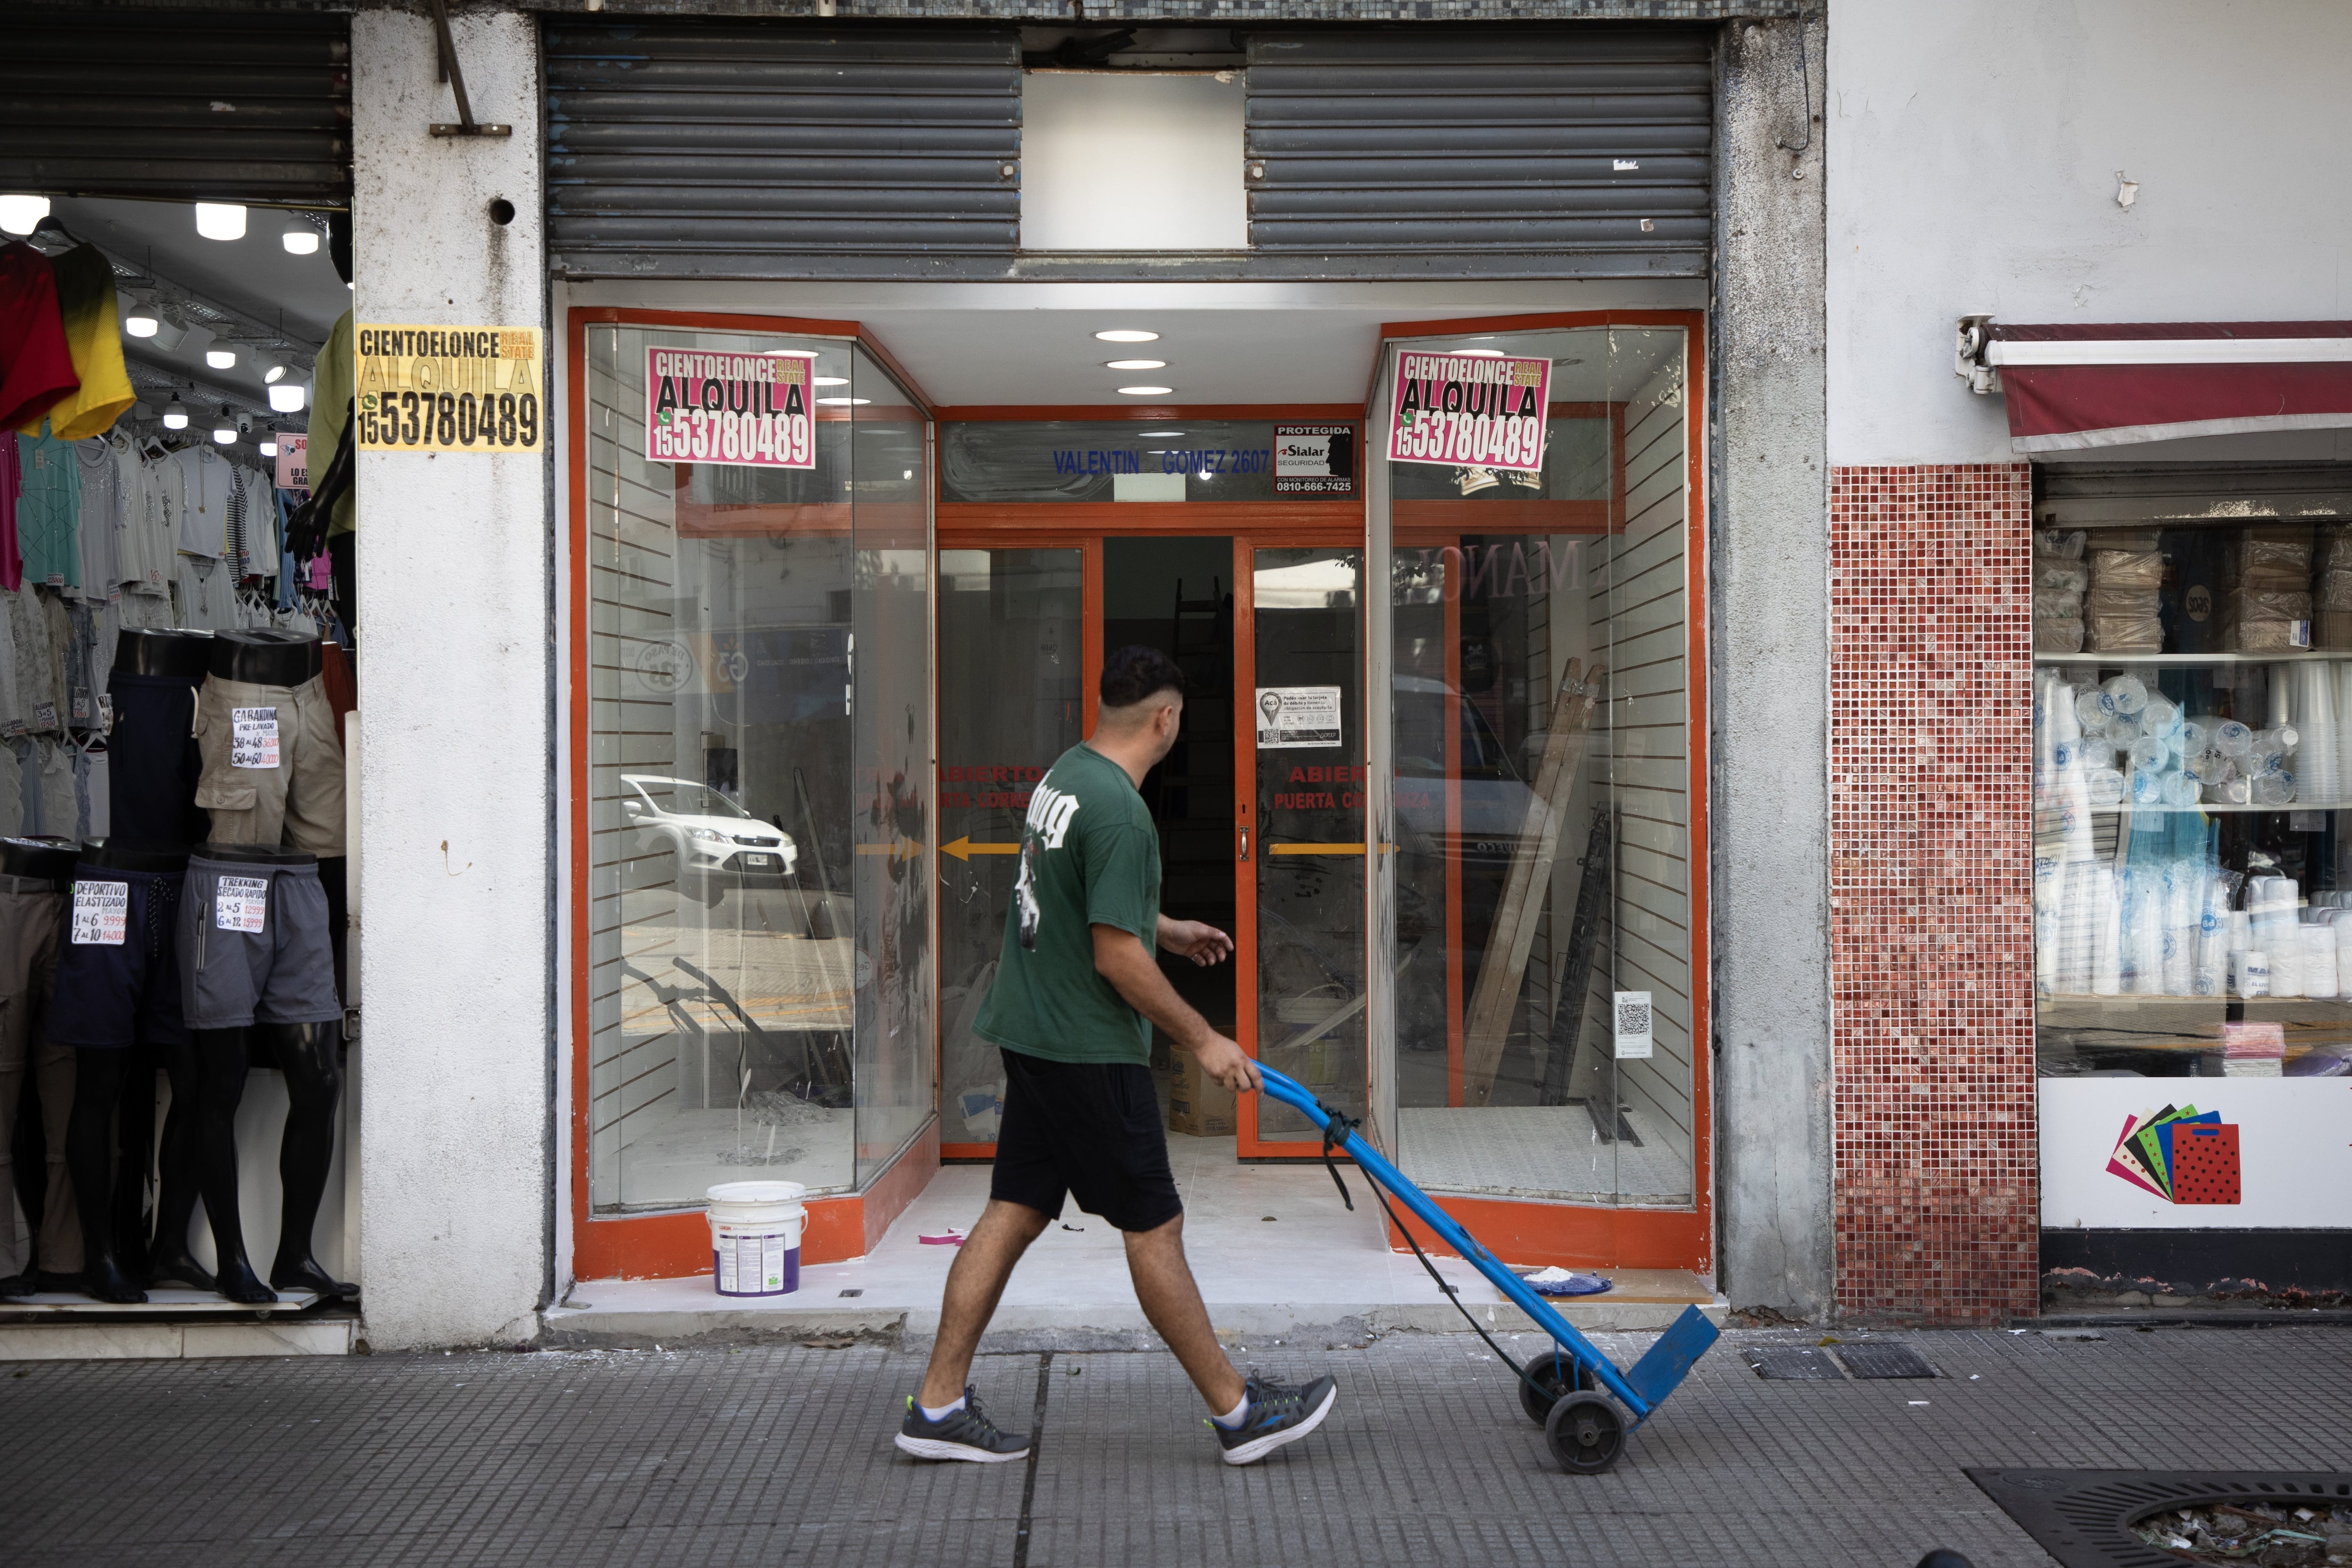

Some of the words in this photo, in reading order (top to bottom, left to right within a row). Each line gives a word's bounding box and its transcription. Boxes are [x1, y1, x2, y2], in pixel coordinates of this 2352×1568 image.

[360, 329, 499, 358] CIENTOELONCE
[500, 331, 534, 347] REAL
[500, 346, 534, 360] STATE
[656, 352, 776, 383] CIENTOELONCE
[776, 359, 806, 372] REAL
[1404, 355, 1515, 385] CIENTOELONCE
[1514, 361, 1542, 376] REAL
[359, 356, 536, 400] ALQUILA
[776, 371, 806, 385] STATE
[1513, 374, 1541, 387] STATE
[655, 376, 807, 420] ALQUILA
[1398, 379, 1538, 422] ALQUILA
[358, 411, 379, 445] 15
[380, 391, 537, 446] 53780489
[653, 425, 673, 457] 15
[674, 408, 809, 463] 53780489
[1396, 426, 1413, 456] 15
[1413, 410, 1540, 465] 53780489
[1288, 445, 1325, 456] Sialar
[1054, 450, 1139, 474] VALENTIN
[1162, 449, 1226, 474] GOMEZ
[1230, 449, 1270, 473] 2607
[291, 468, 300, 477] LO
[1276, 483, 1351, 491] 0810-666-7425
[35, 701, 54, 711] ALGODON
[233, 709, 277, 723] GABARDINA
[41, 720, 56, 729] 17500
[233, 737, 245, 748] 38
[252, 737, 262, 748] 48
[232, 753, 245, 764] 50
[251, 752, 262, 765] 60
[1274, 793, 1335, 809] PUERTA
[76, 883, 126, 896] DEPORTIVO
[222, 877, 264, 889] TREKKING
[218, 886, 244, 898] SECADO
[244, 889, 267, 899] RAPIDO
[75, 896, 126, 907] ELASTIZADO
[218, 902, 223, 912] 2
[232, 902, 241, 913] 5
[245, 905, 265, 915] 12999
[75, 913, 79, 926] 1
[90, 913, 99, 926] 6
[103, 915, 127, 926] 9999
[218, 915, 224, 926] 6
[232, 916, 241, 927] 12
[243, 917, 263, 928] 15999
[74, 928, 81, 942] 7
[90, 928, 101, 941] 10
[103, 930, 126, 940] 14000
